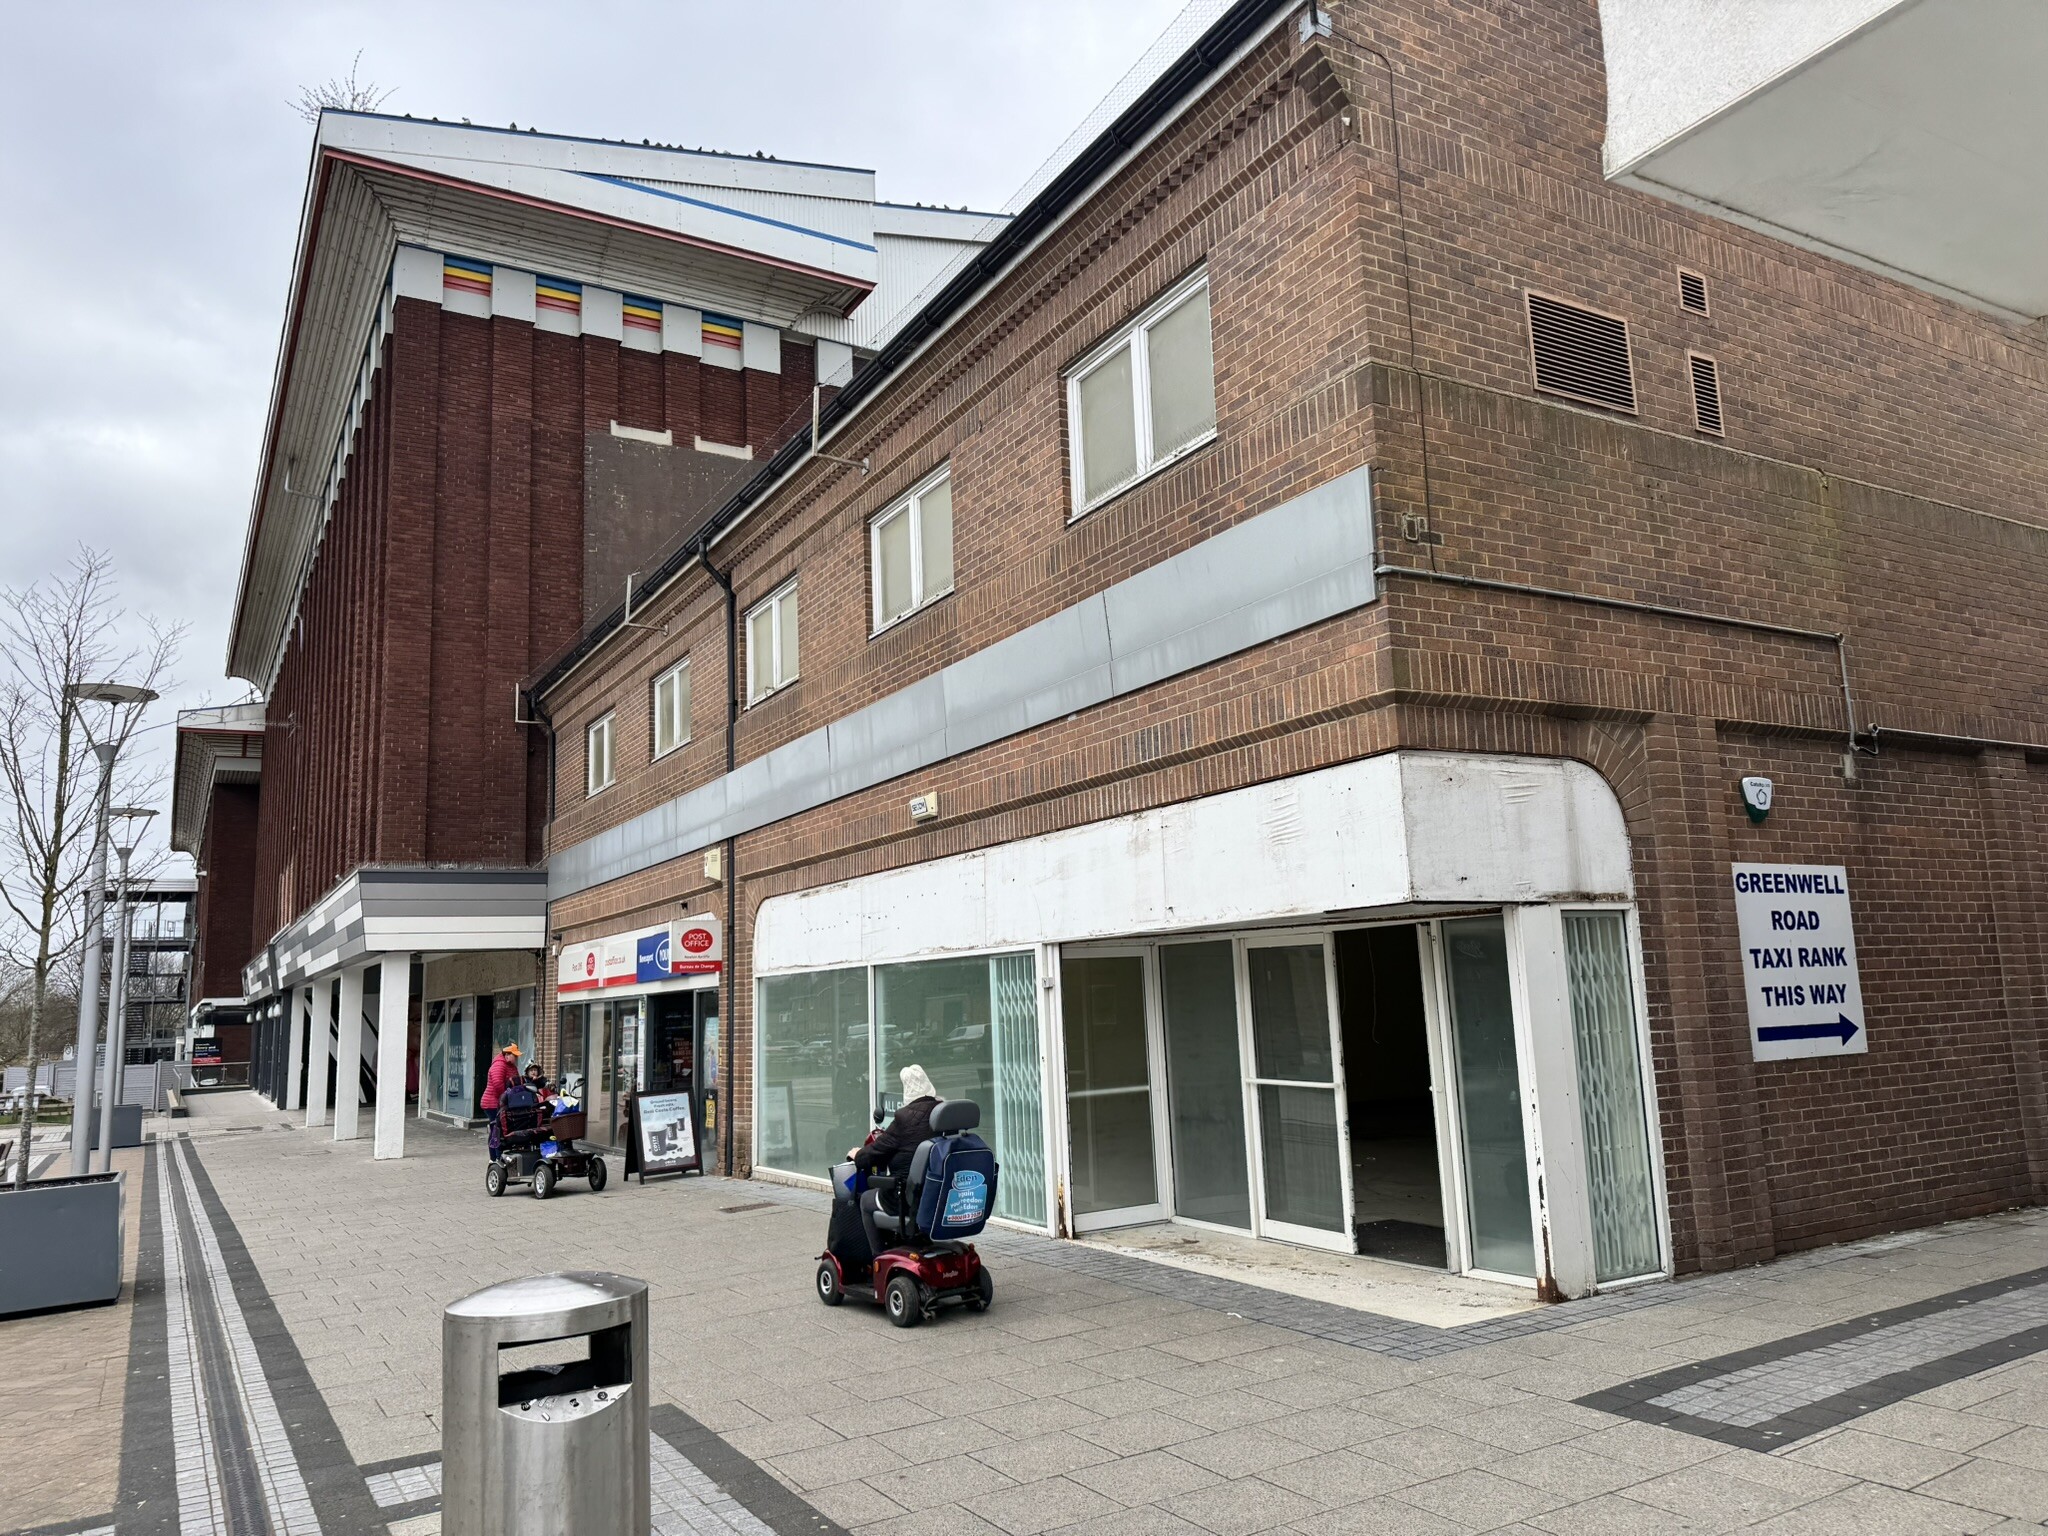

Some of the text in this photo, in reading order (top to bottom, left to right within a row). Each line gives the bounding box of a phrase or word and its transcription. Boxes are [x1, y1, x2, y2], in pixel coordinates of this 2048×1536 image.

[1735, 872, 1845, 894] GREENWELL
[1771, 910, 1820, 931] ROAD
[684, 939, 709, 947] OFFICE
[1749, 947, 1848, 969] TAXI RANK
[1761, 984, 1847, 1007] THIS WAY
[884, 1100, 895, 1112] ALL
[956, 1174, 978, 1182] Eden
